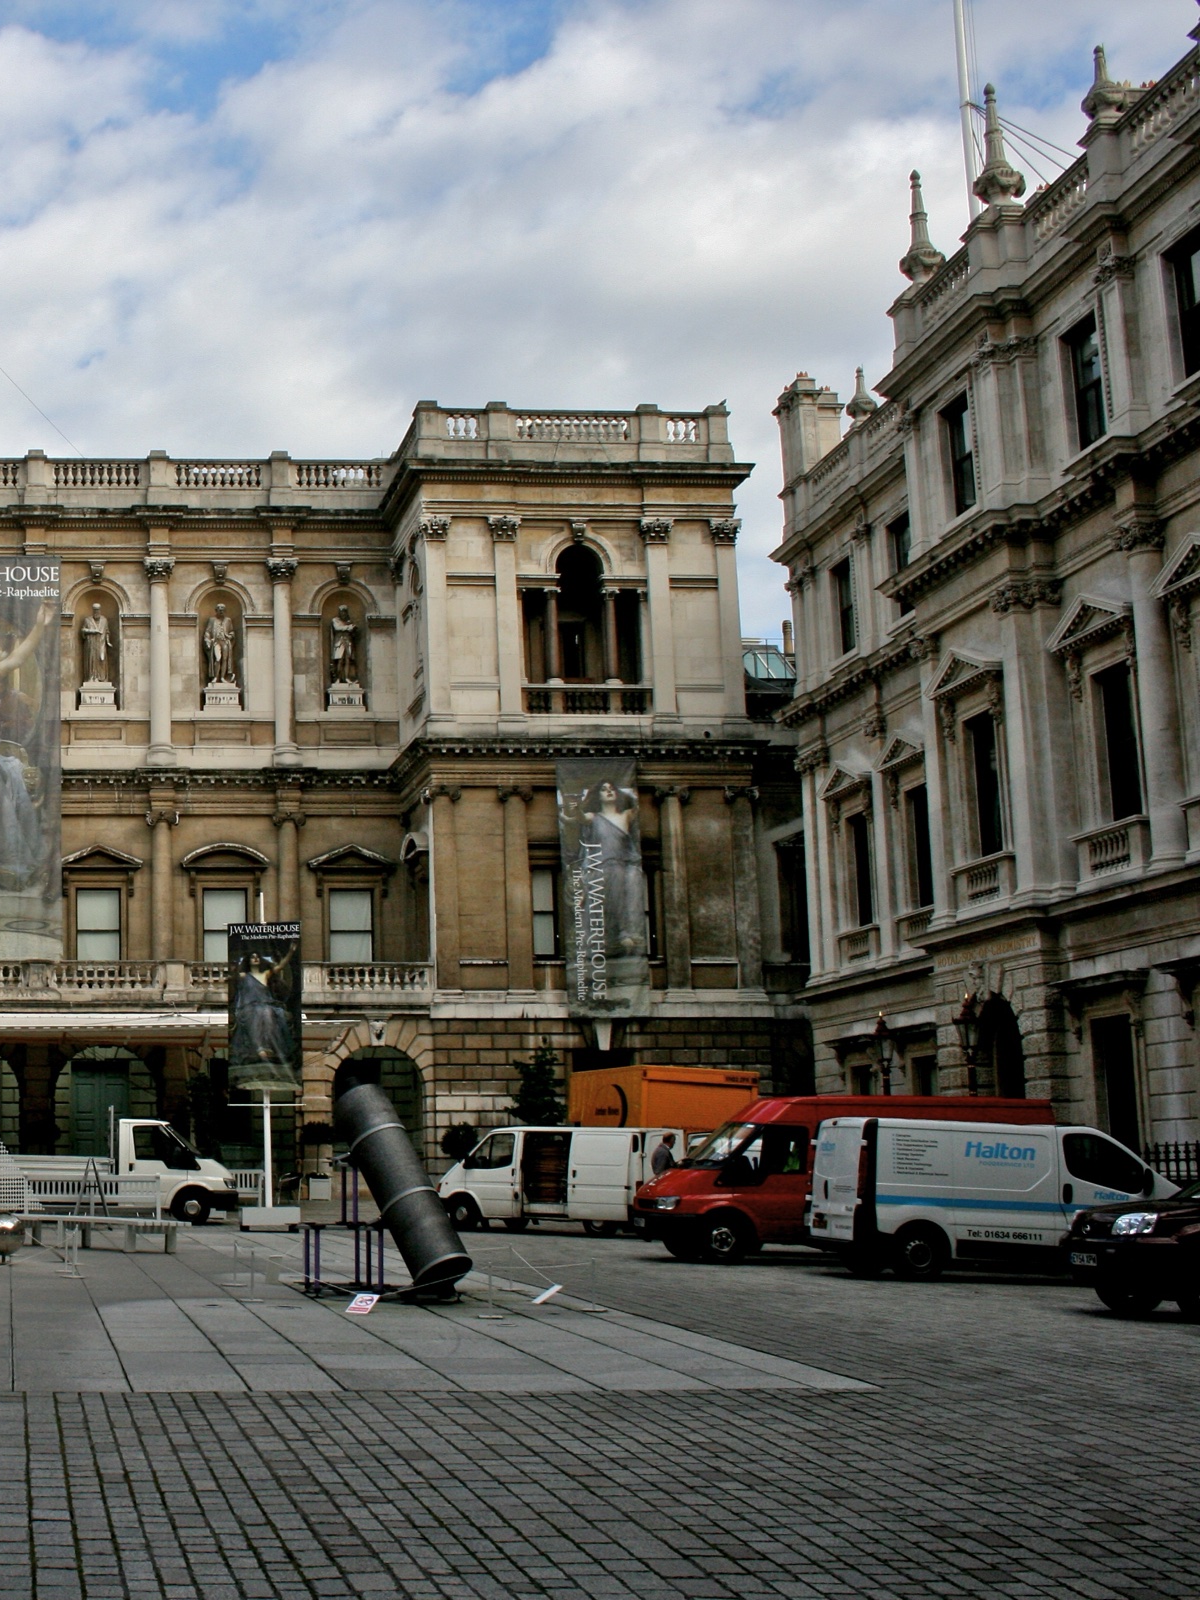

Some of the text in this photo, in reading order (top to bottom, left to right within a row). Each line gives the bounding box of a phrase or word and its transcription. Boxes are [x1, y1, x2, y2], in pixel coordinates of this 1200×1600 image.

[579, 839, 607, 1000] J.W. WATERHOUSE
[230, 925, 299, 936] J.W. WATERHOUSE
[572, 868, 589, 1001] The Modern Pre-Raphaelite
[964, 1141, 1036, 1160] Halton
[1093, 1190, 1129, 1201] Halton
[967, 1229, 1042, 1241] Tel: 01634 666111
